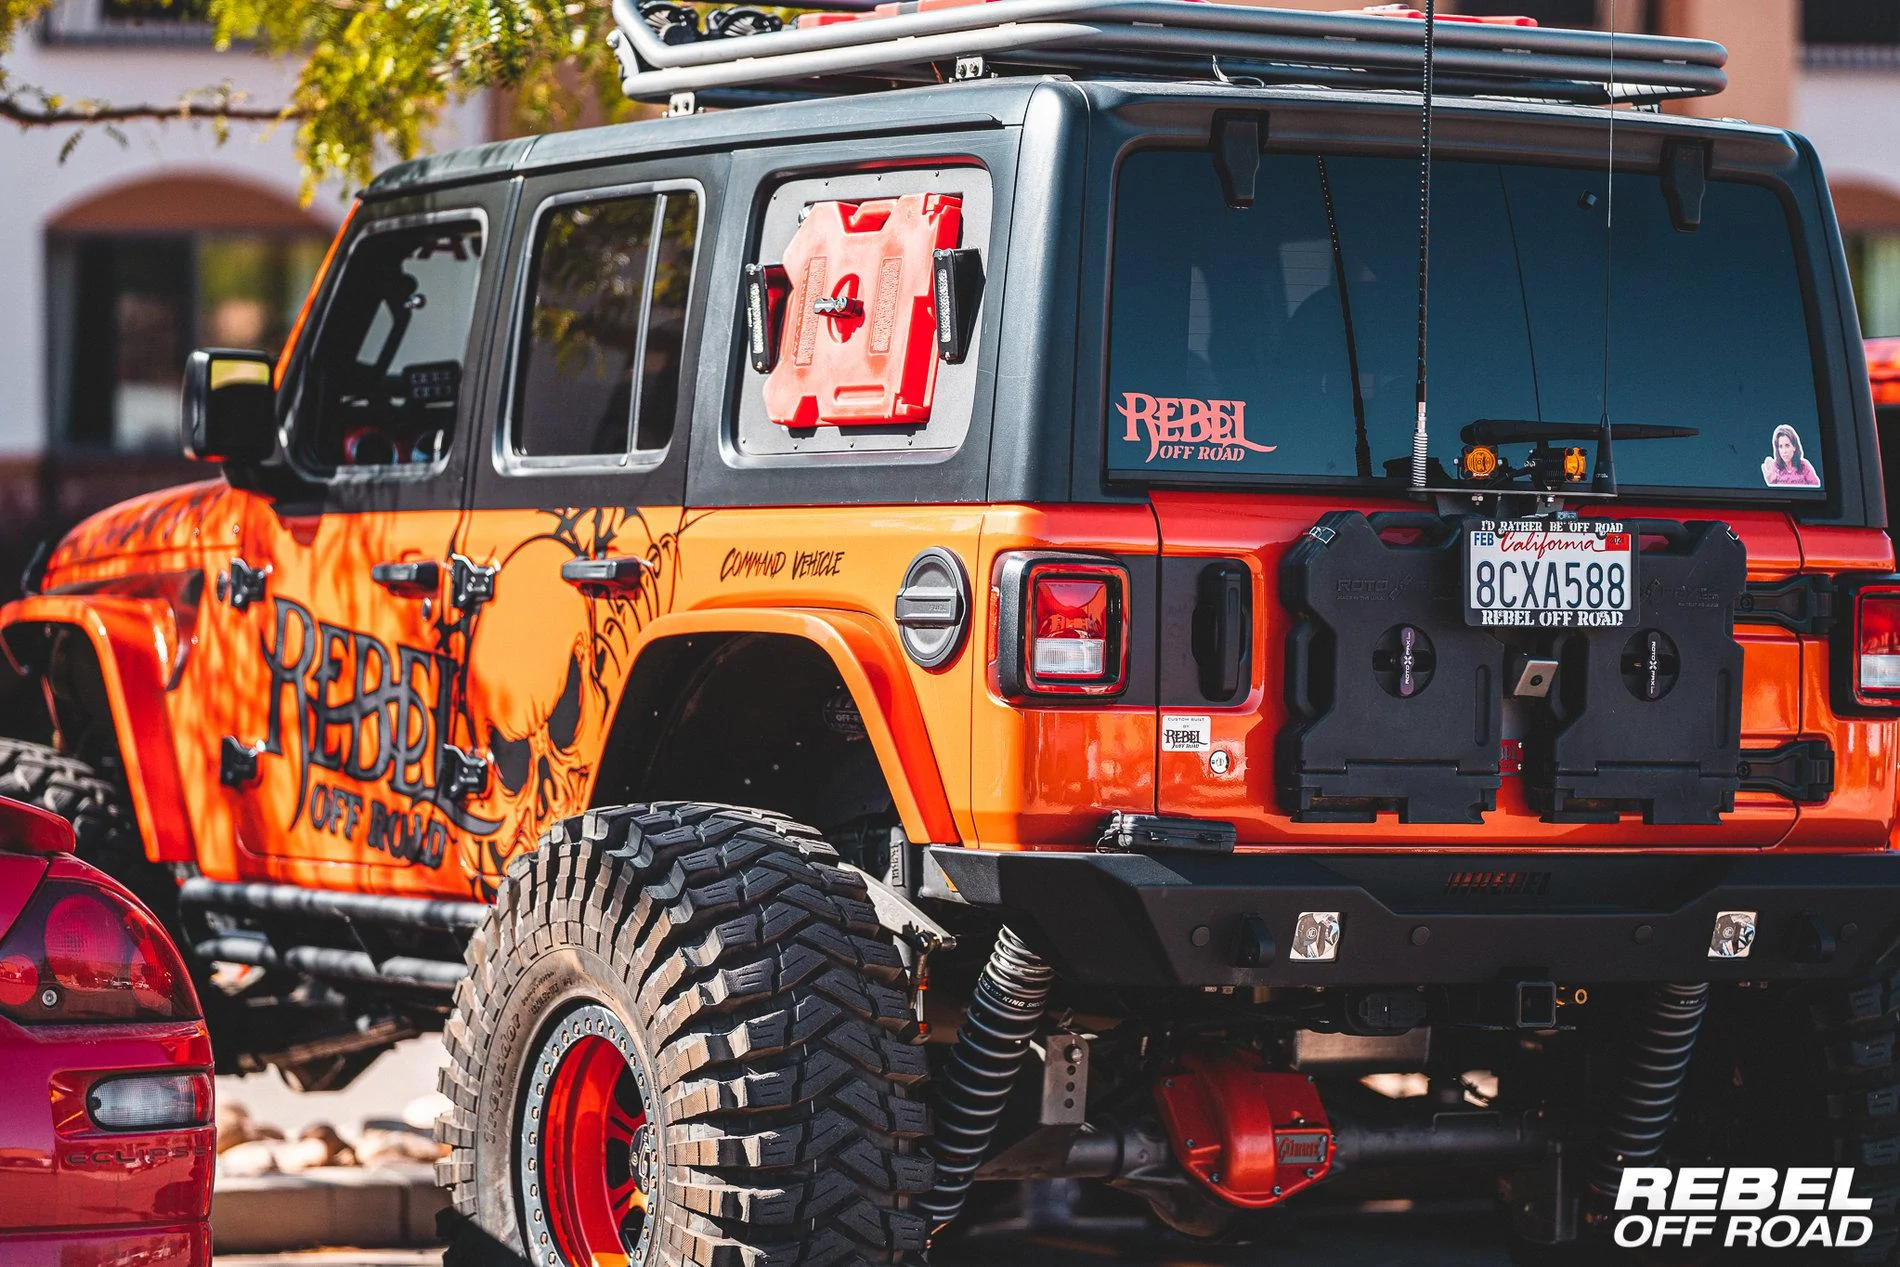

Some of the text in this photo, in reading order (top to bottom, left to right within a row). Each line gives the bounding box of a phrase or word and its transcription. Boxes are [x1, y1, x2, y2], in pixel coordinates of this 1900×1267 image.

[1115, 392, 1278, 463] REBEL
[1159, 445, 1245, 462] OFF ROAD
[1481, 520, 1623, 533] I'D RATHER BE OFF ROAD
[1474, 532, 1494, 546] FEB
[1501, 532, 1606, 559] California
[720, 547, 845, 582] COMMAND VEHICLE
[1476, 560, 1625, 609] 8CXA588
[1481, 610, 1624, 626] REBEL OFF ROAD
[259, 596, 506, 836] REBEL
[1164, 729, 1208, 749] REBEL
[310, 783, 364, 840] OFF
[1002, 996, 1026, 1007] KING
[65, 1145, 206, 1165] ECLIPSE
